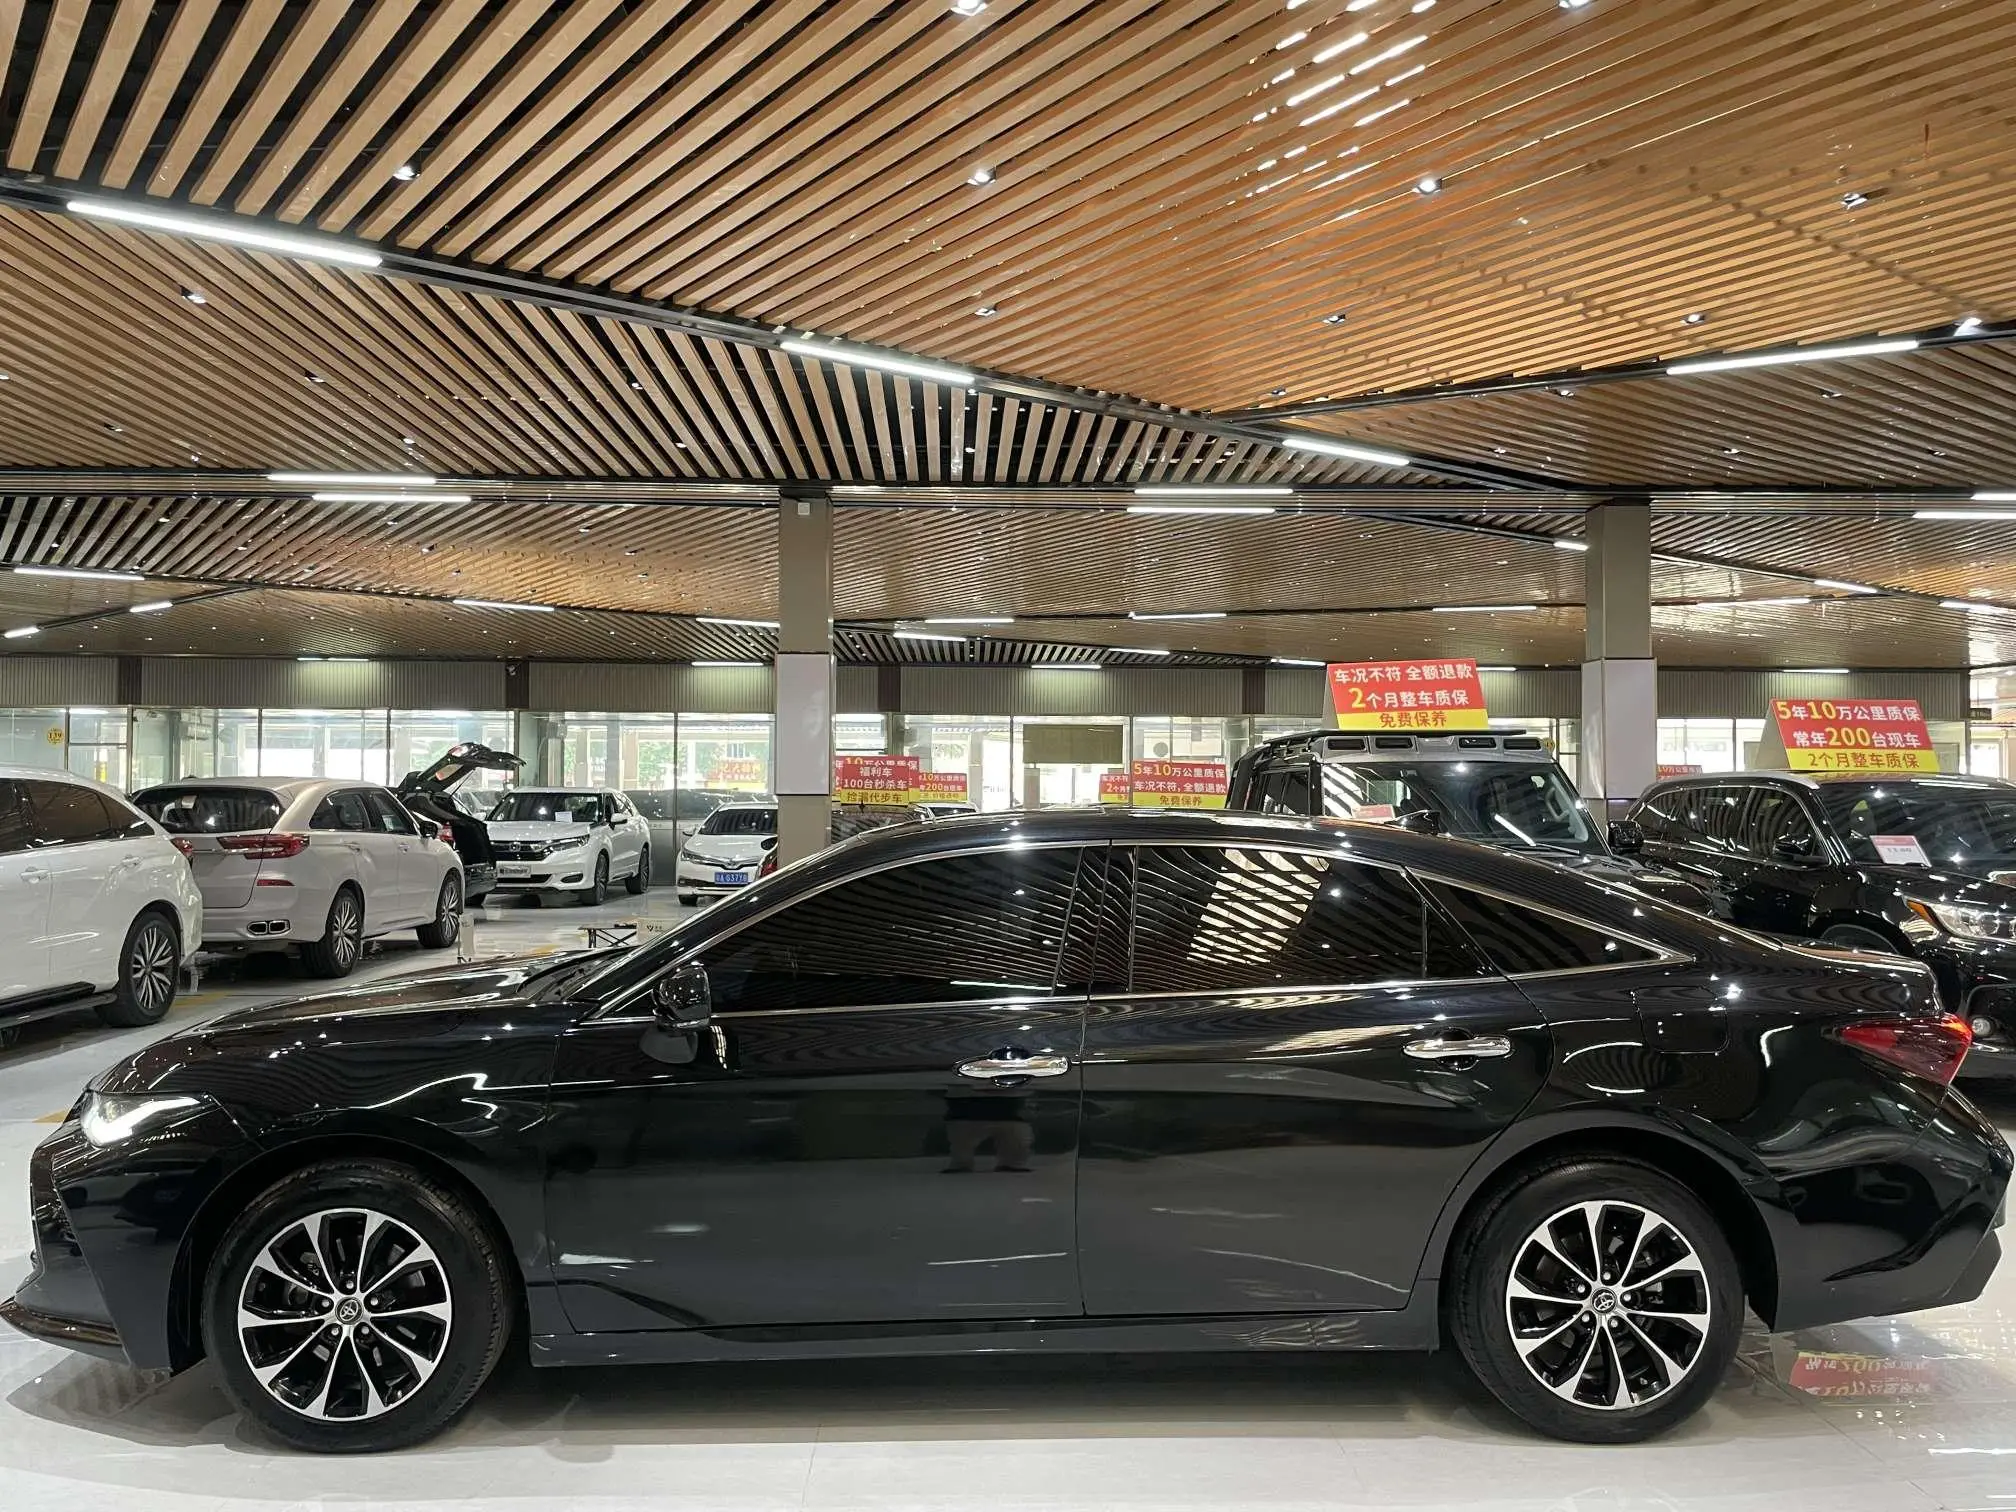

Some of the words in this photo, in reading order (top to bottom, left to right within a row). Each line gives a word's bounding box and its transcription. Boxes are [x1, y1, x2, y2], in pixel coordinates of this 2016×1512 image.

[1335, 666, 1401, 684] 车况不符
[1406, 663, 1474, 681] 全额退款
[1348, 687, 1469, 709] 2个月整车质保
[1380, 711, 1447, 728] 免费保养
[1776, 701, 1921, 722] 5年10万公里质保
[1793, 727, 1922, 748] 常年200台现车
[1808, 753, 1920, 769] 2个月整车质保
[860, 767, 893, 777] 福利车
[1134, 763, 1225, 779] 5年10万公里质保
[844, 779, 908, 791] 100台秒杀车
[1160, 794, 1202, 806] 免费保养
